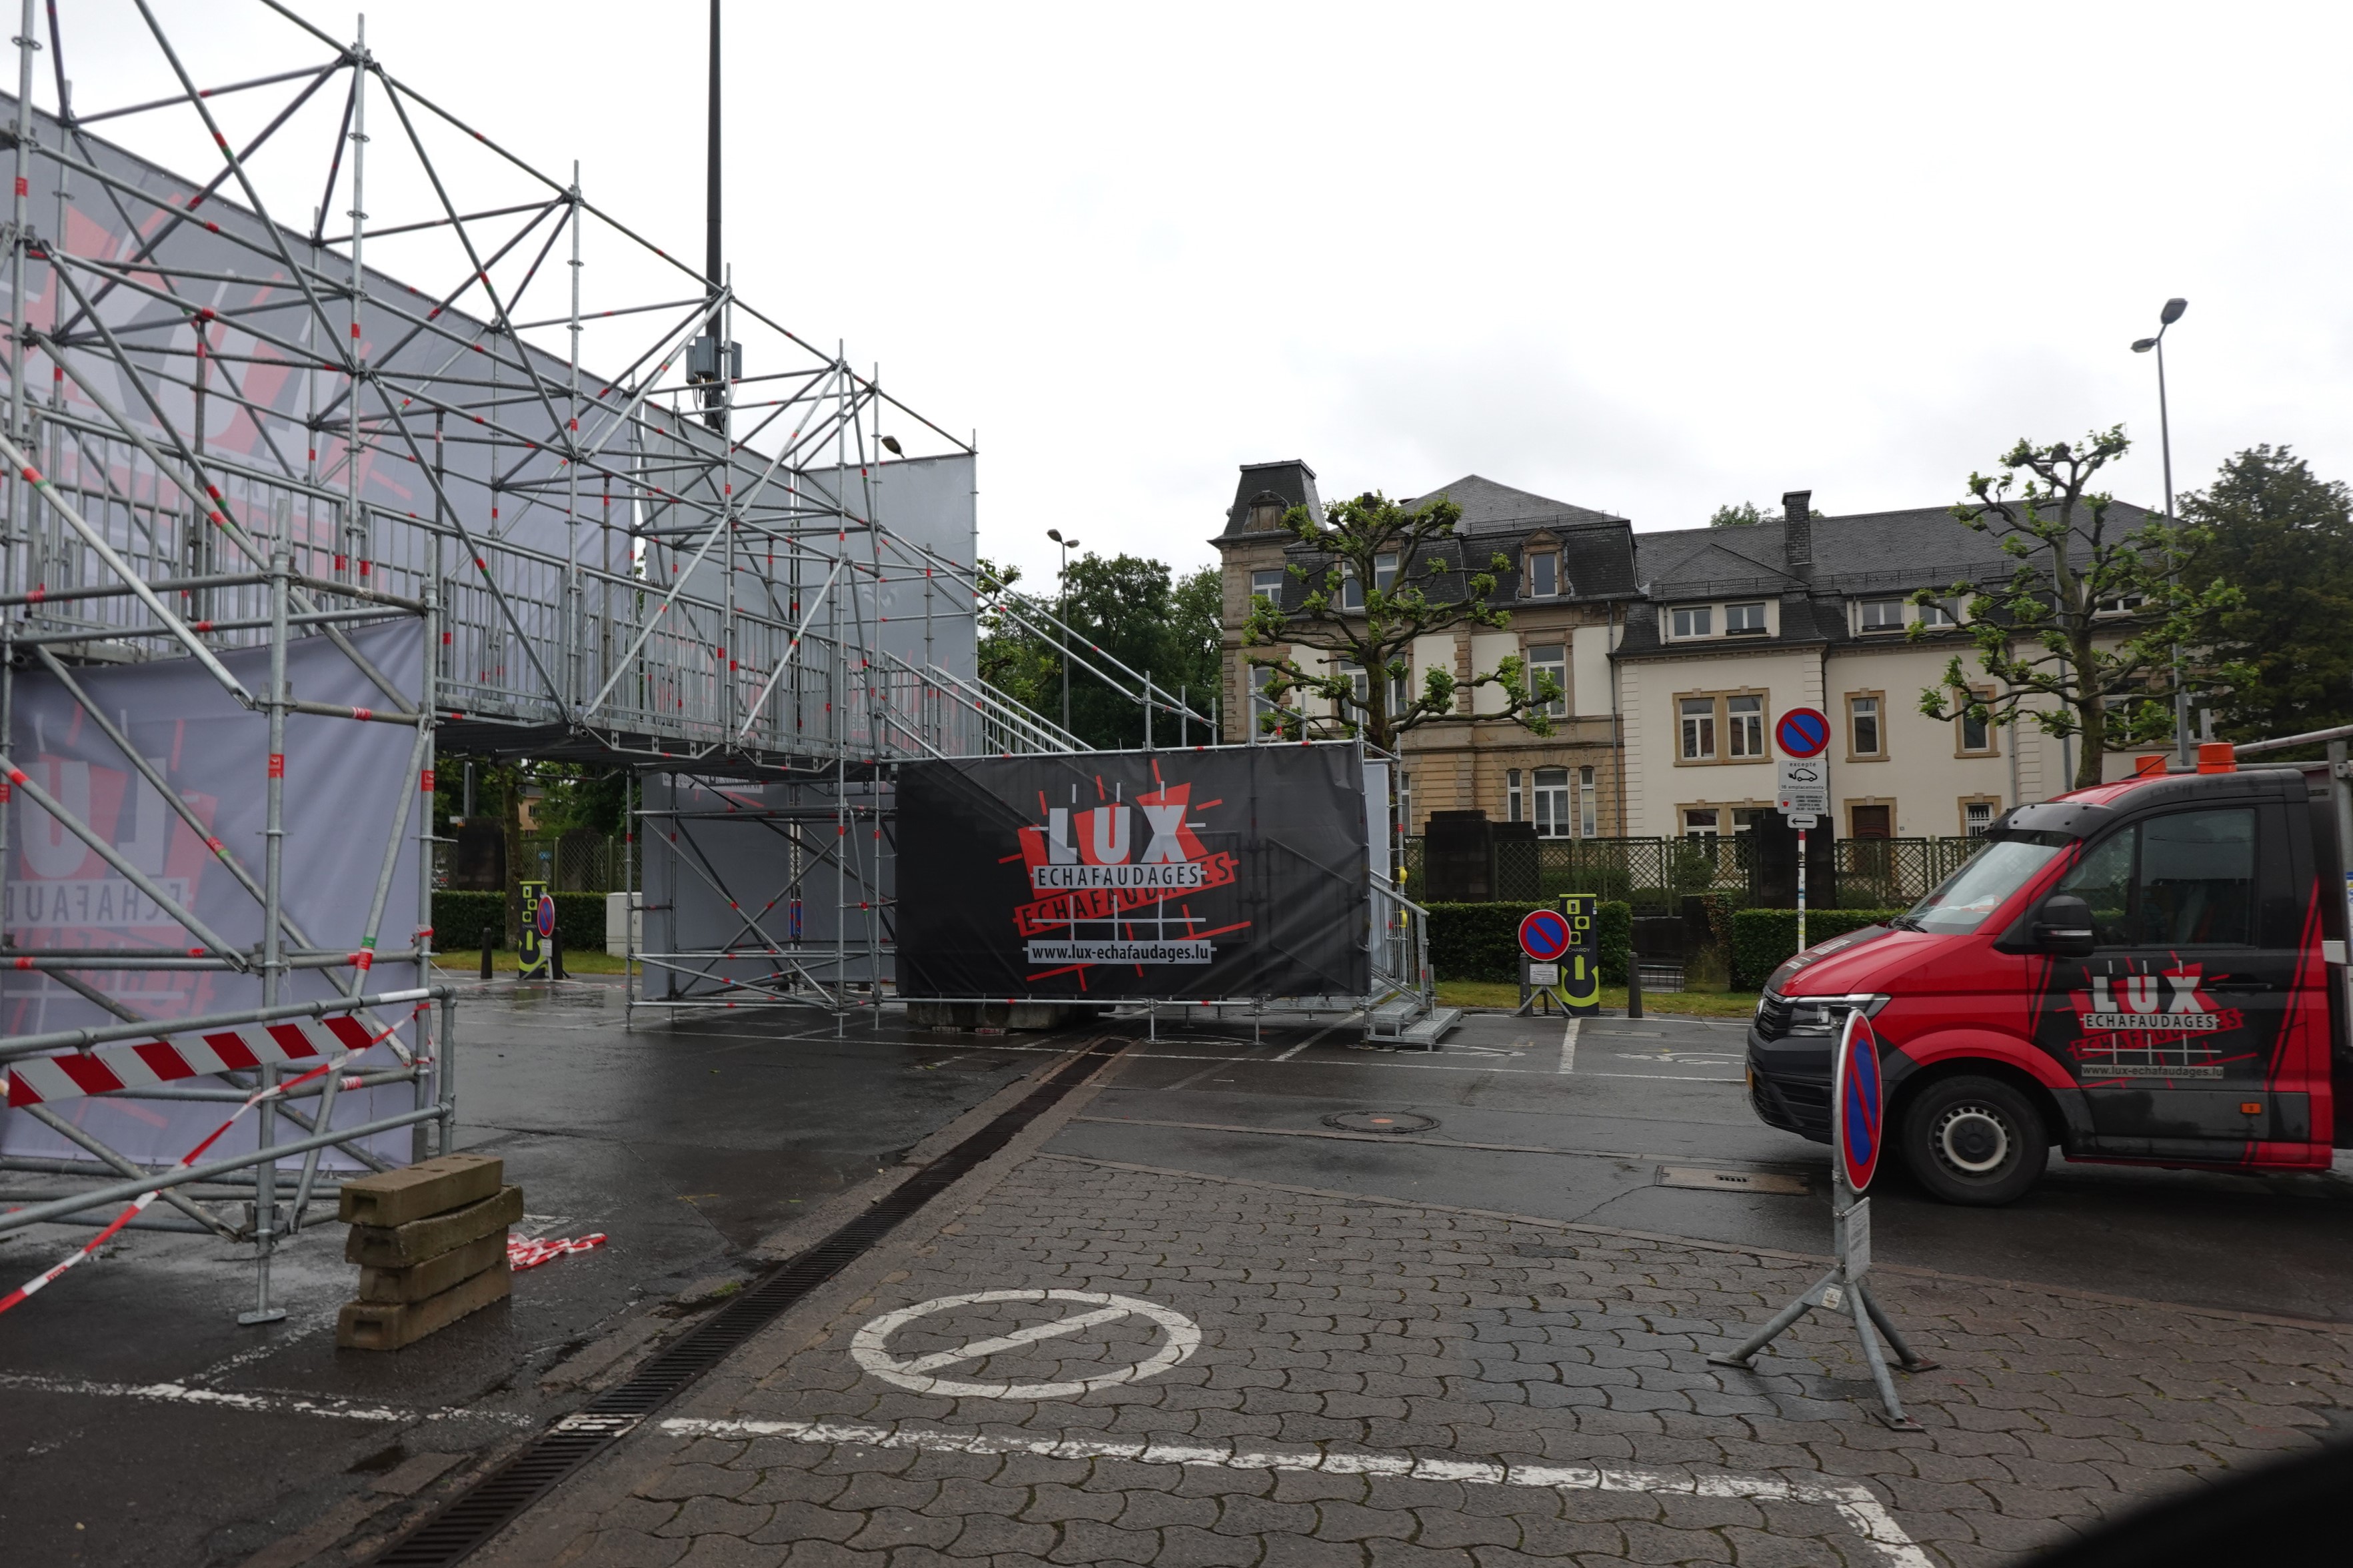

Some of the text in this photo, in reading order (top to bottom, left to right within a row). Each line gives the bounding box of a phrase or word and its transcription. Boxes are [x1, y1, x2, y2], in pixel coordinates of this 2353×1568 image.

[1049, 804, 1188, 864] LUX
[1038, 866, 1198, 886] ECHAFAUDAGES
[1032, 944, 1208, 962] www.lux-echafaudages.lu
[2092, 976, 2204, 1014] LUX
[2086, 1015, 2214, 1028] ECHAFAUDAGES
[2082, 1066, 2223, 1078] www.lux-echafaudages.lu
